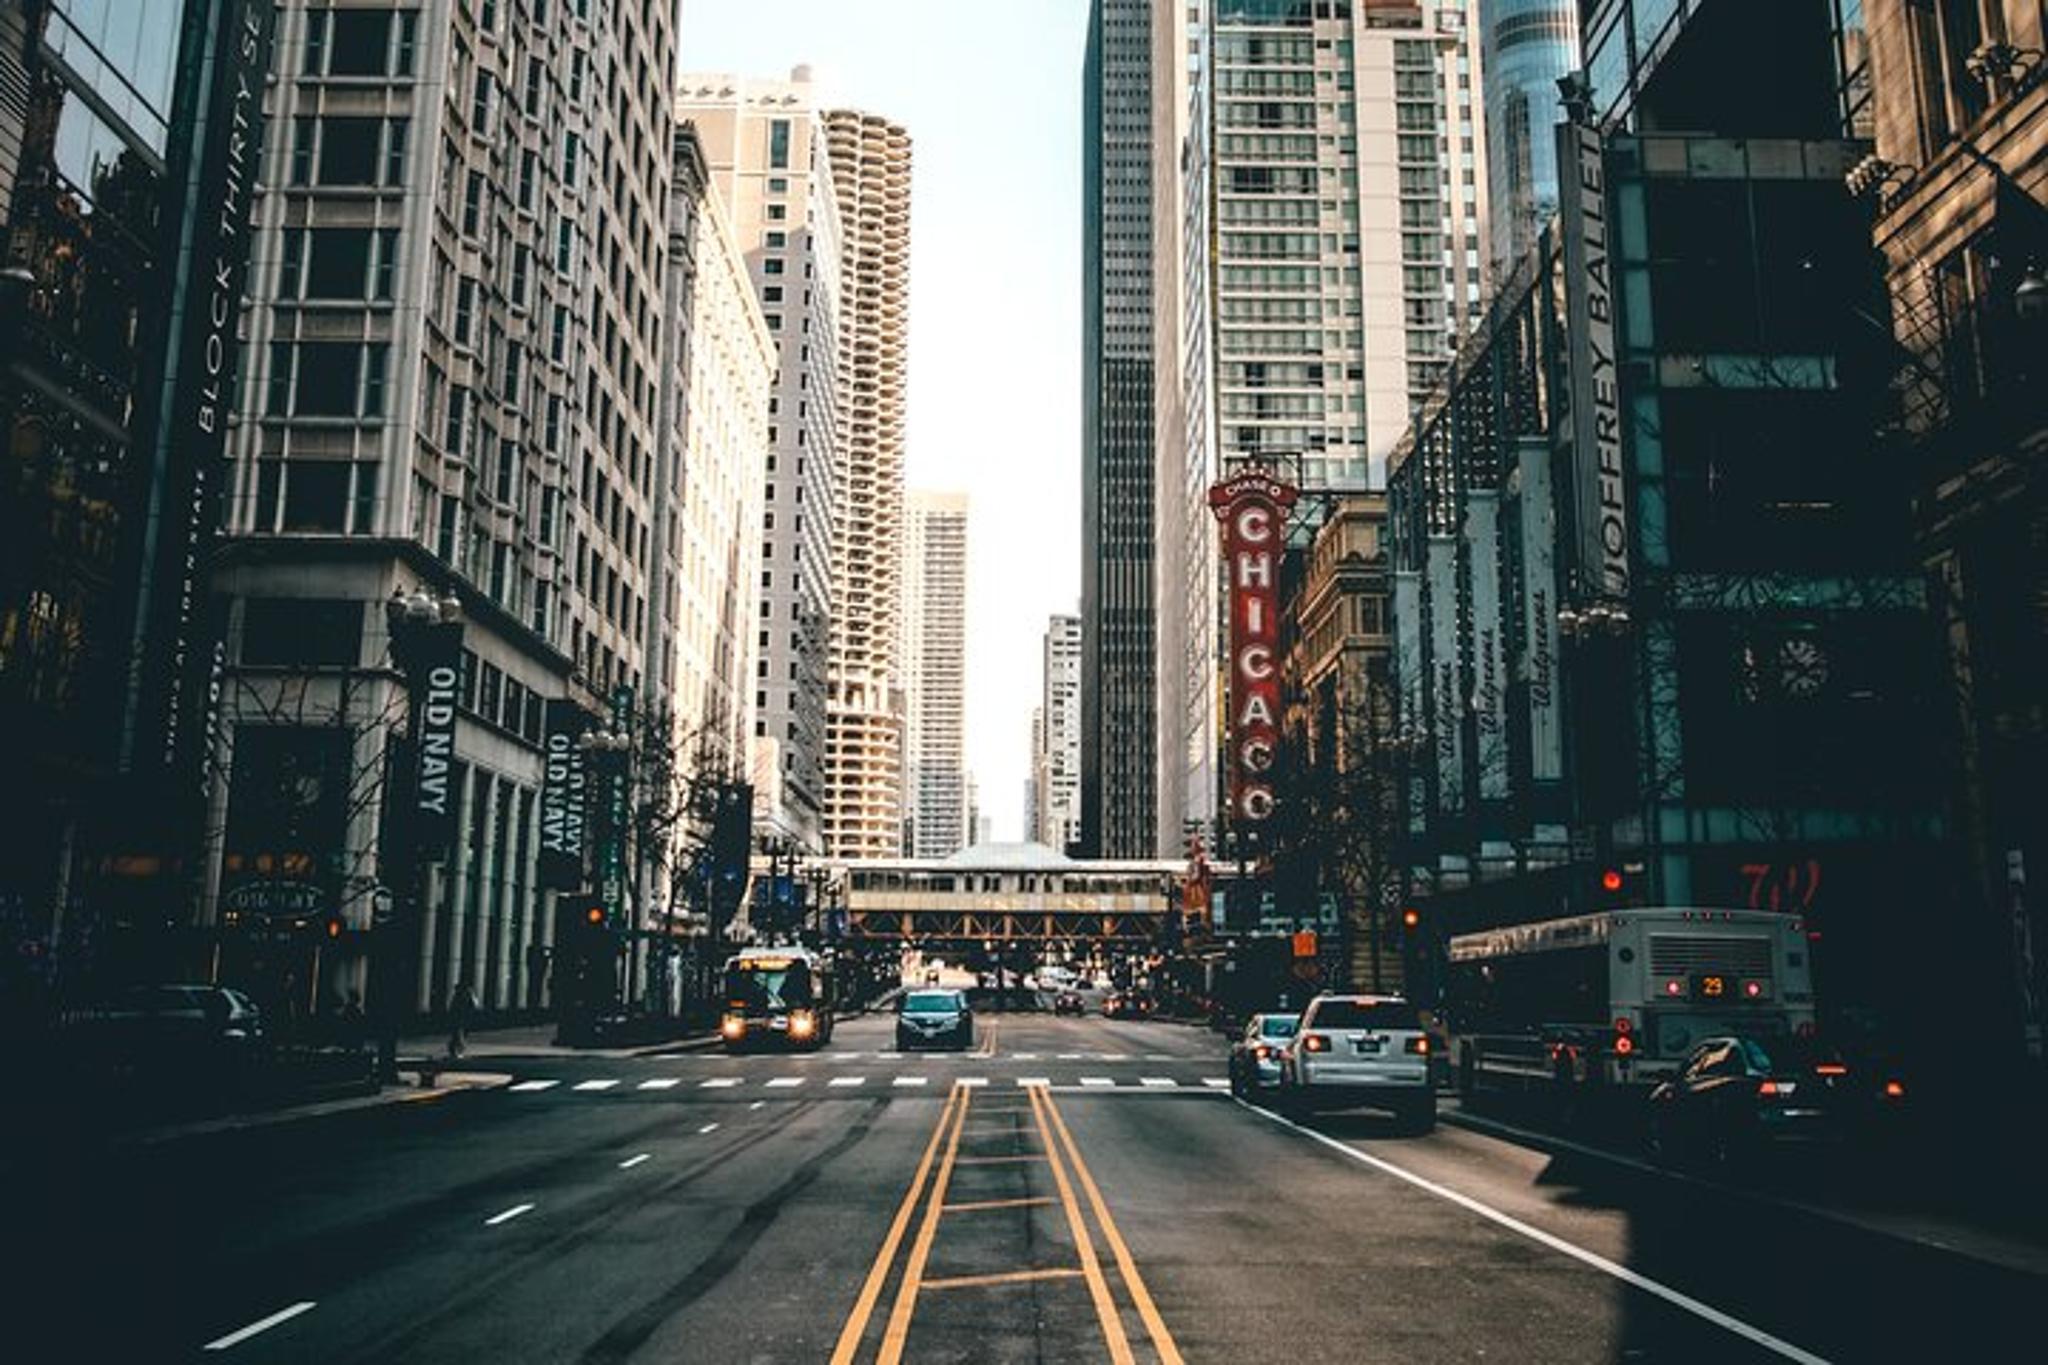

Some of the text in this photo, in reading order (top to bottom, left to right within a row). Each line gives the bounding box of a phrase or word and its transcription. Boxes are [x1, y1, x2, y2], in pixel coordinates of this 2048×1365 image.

[198, 257, 232, 434] BLOCK
[219, 72, 252, 236] THIRTY
[1578, 126, 1613, 325] BALLET
[418, 667, 457, 815] OLD NAVY
[541, 733, 570, 854] OLD NAVY
